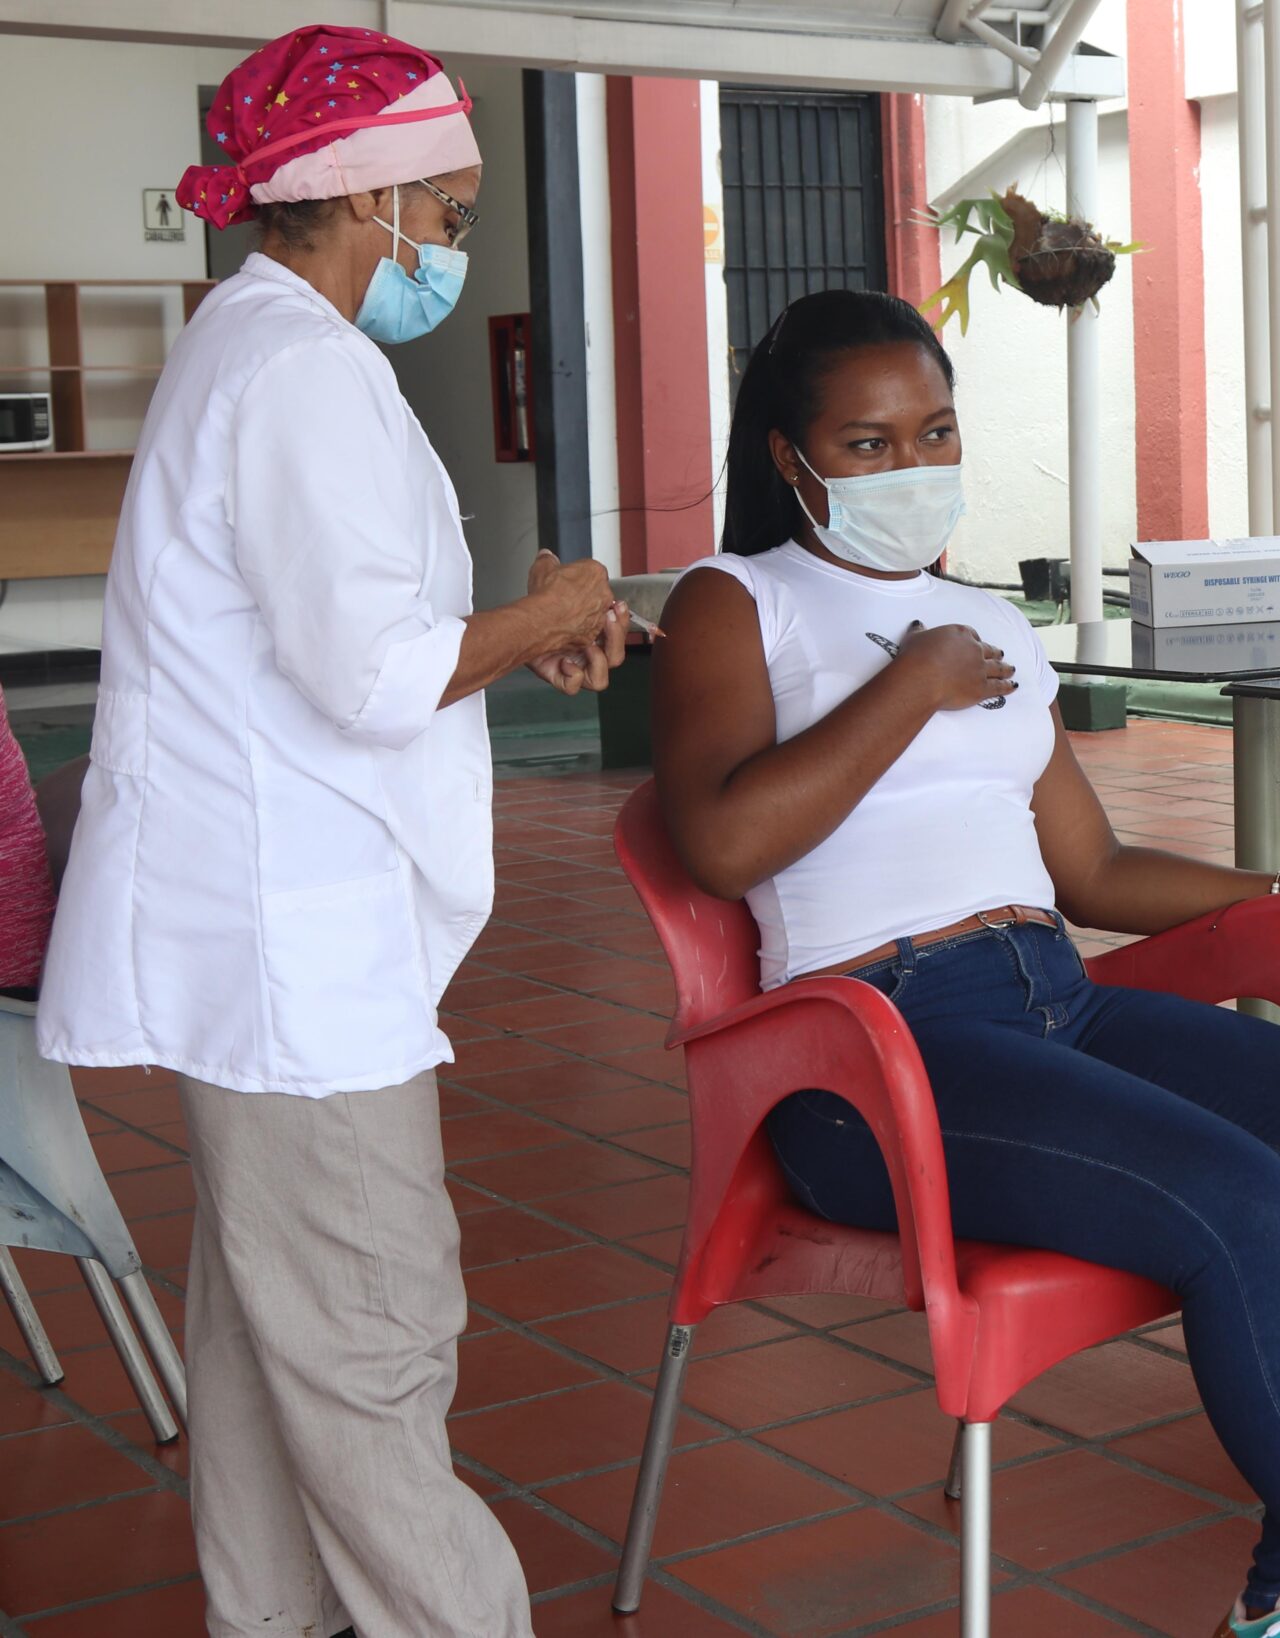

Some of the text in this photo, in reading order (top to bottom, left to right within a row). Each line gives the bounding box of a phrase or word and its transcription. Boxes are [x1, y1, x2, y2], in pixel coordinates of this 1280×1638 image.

[1163, 570, 1191, 579] WEGO
[1204, 577, 1240, 587] DISPOSABLE
[1242, 575, 1268, 585] SYRINGE
